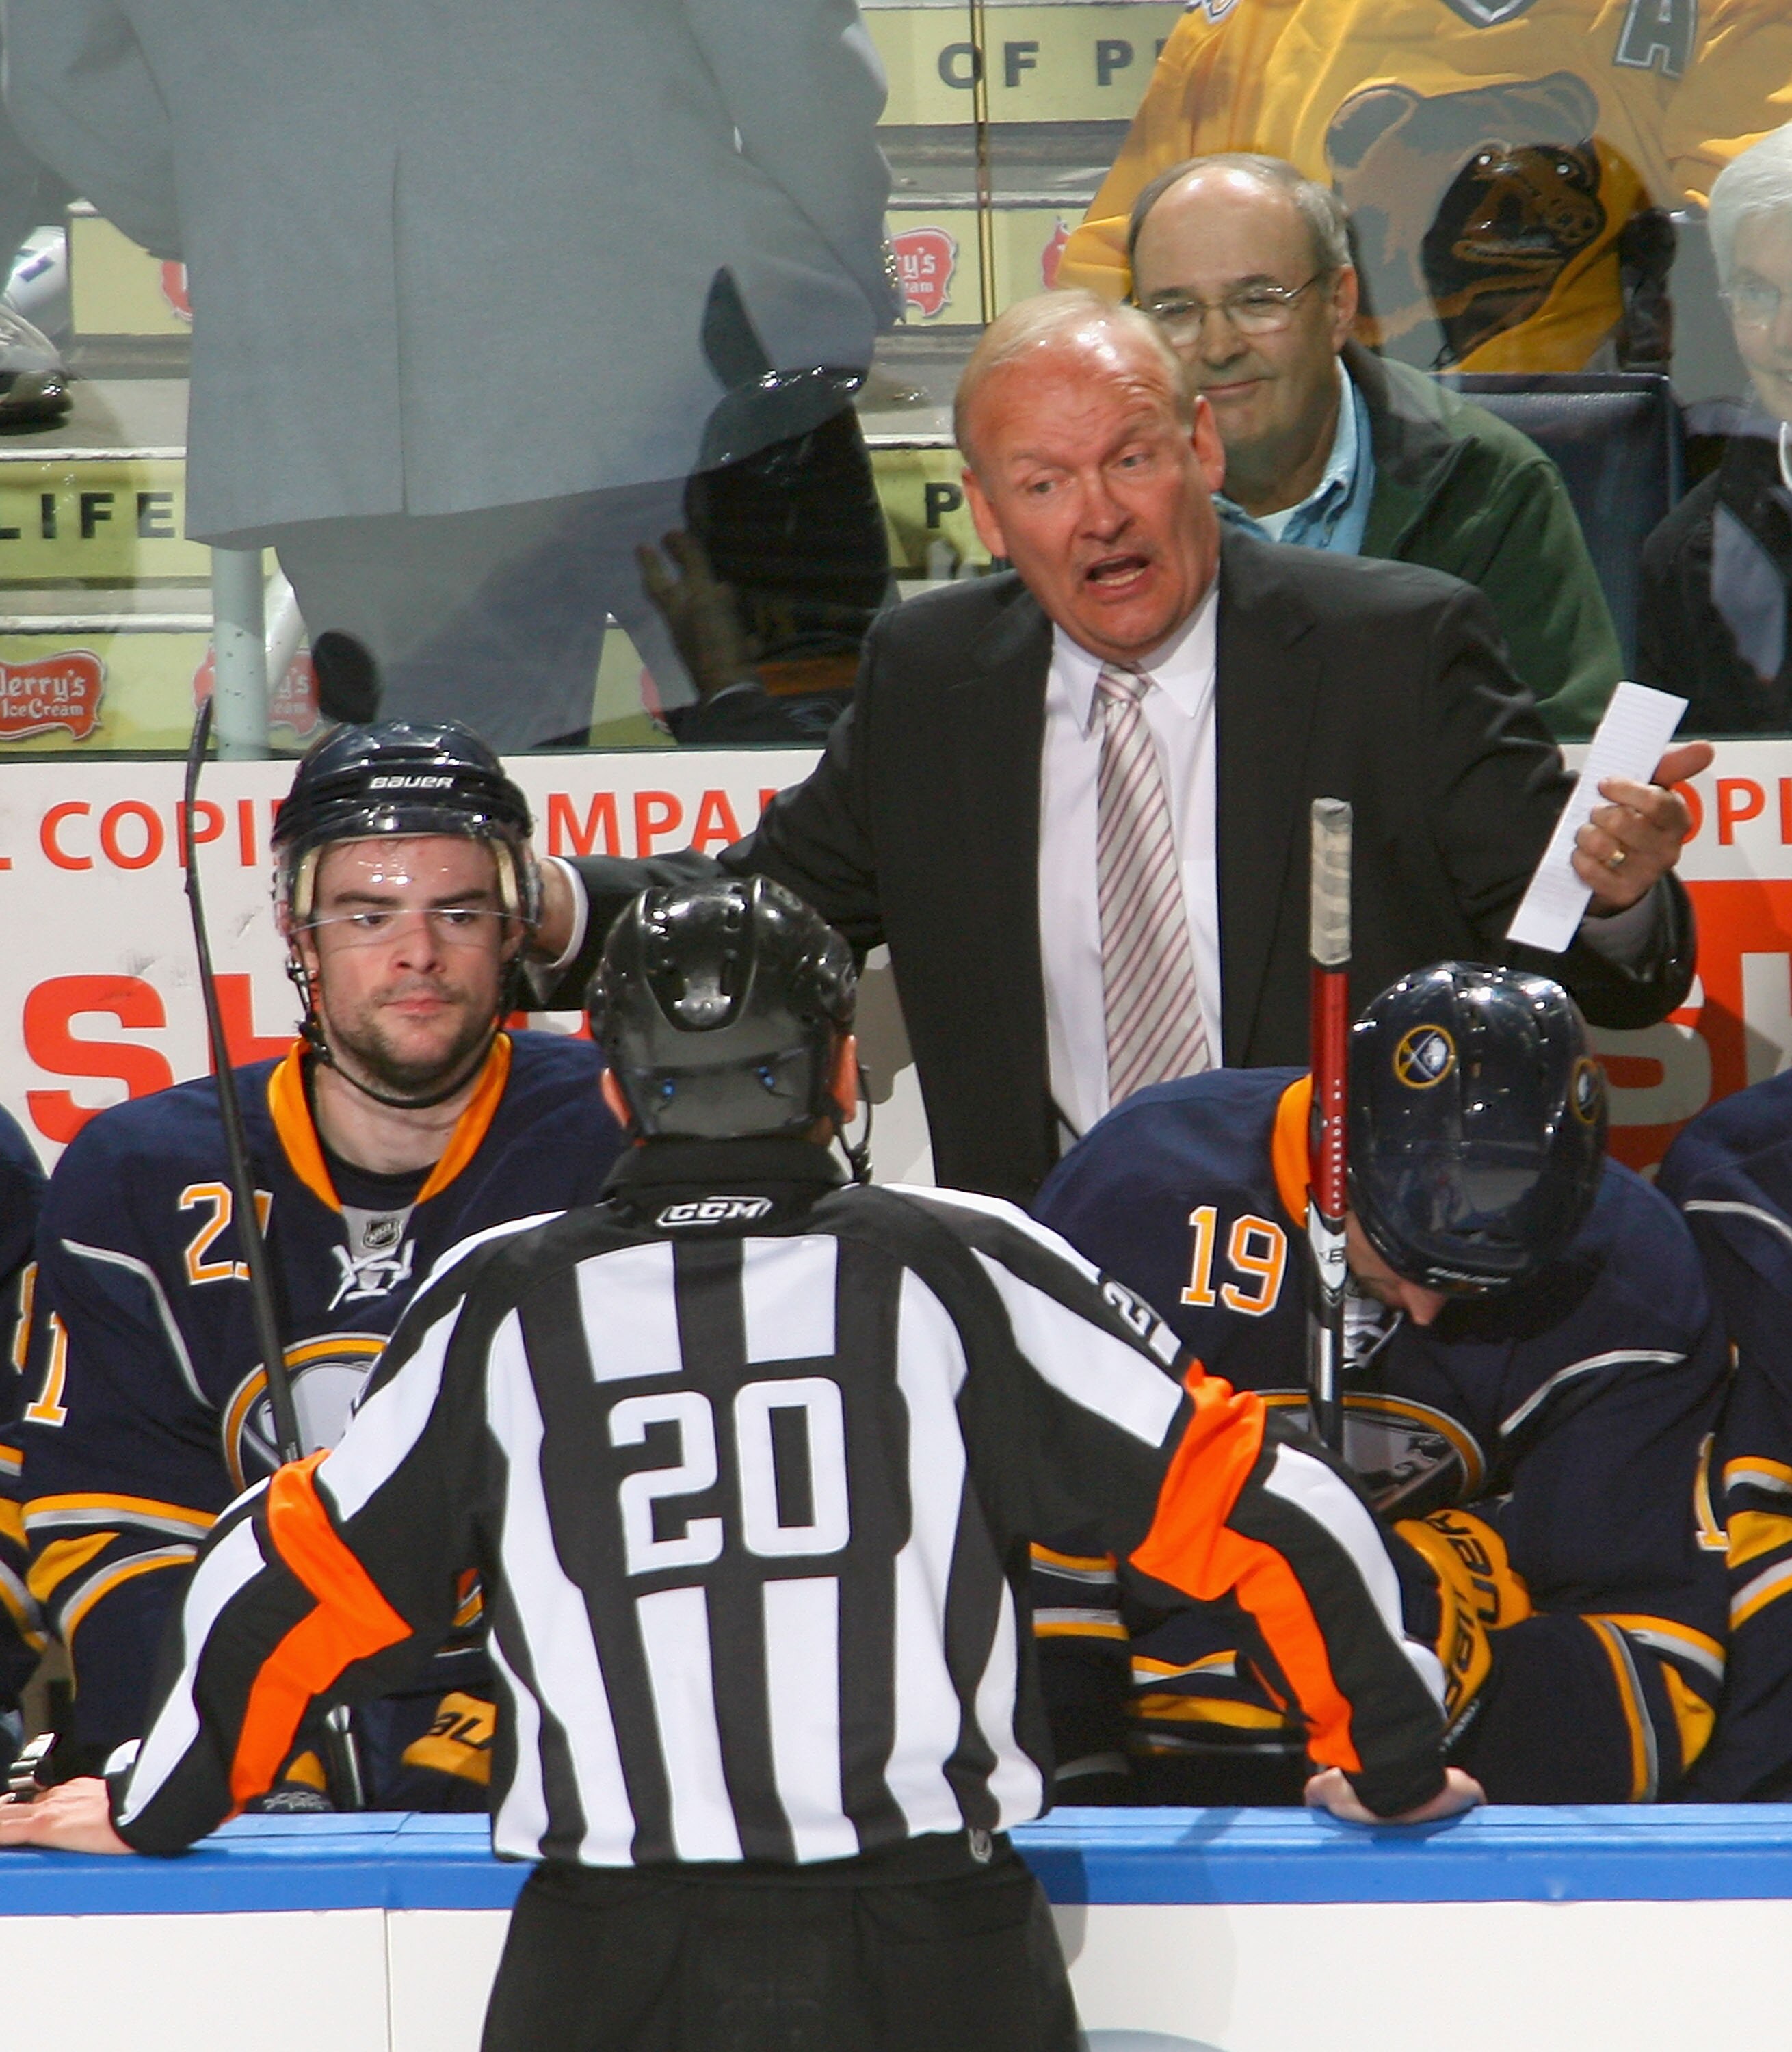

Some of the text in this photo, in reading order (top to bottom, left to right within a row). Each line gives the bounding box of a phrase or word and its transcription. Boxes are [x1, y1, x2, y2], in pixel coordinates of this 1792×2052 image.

[938, 40, 1039, 89] OF
[369, 776, 454, 789] BAUER
[40, 798, 286, 871] COPI
[665, 1200, 765, 1222] CCM
[1180, 1205, 1288, 1317] 19
[608, 1376, 850, 1575] 20
